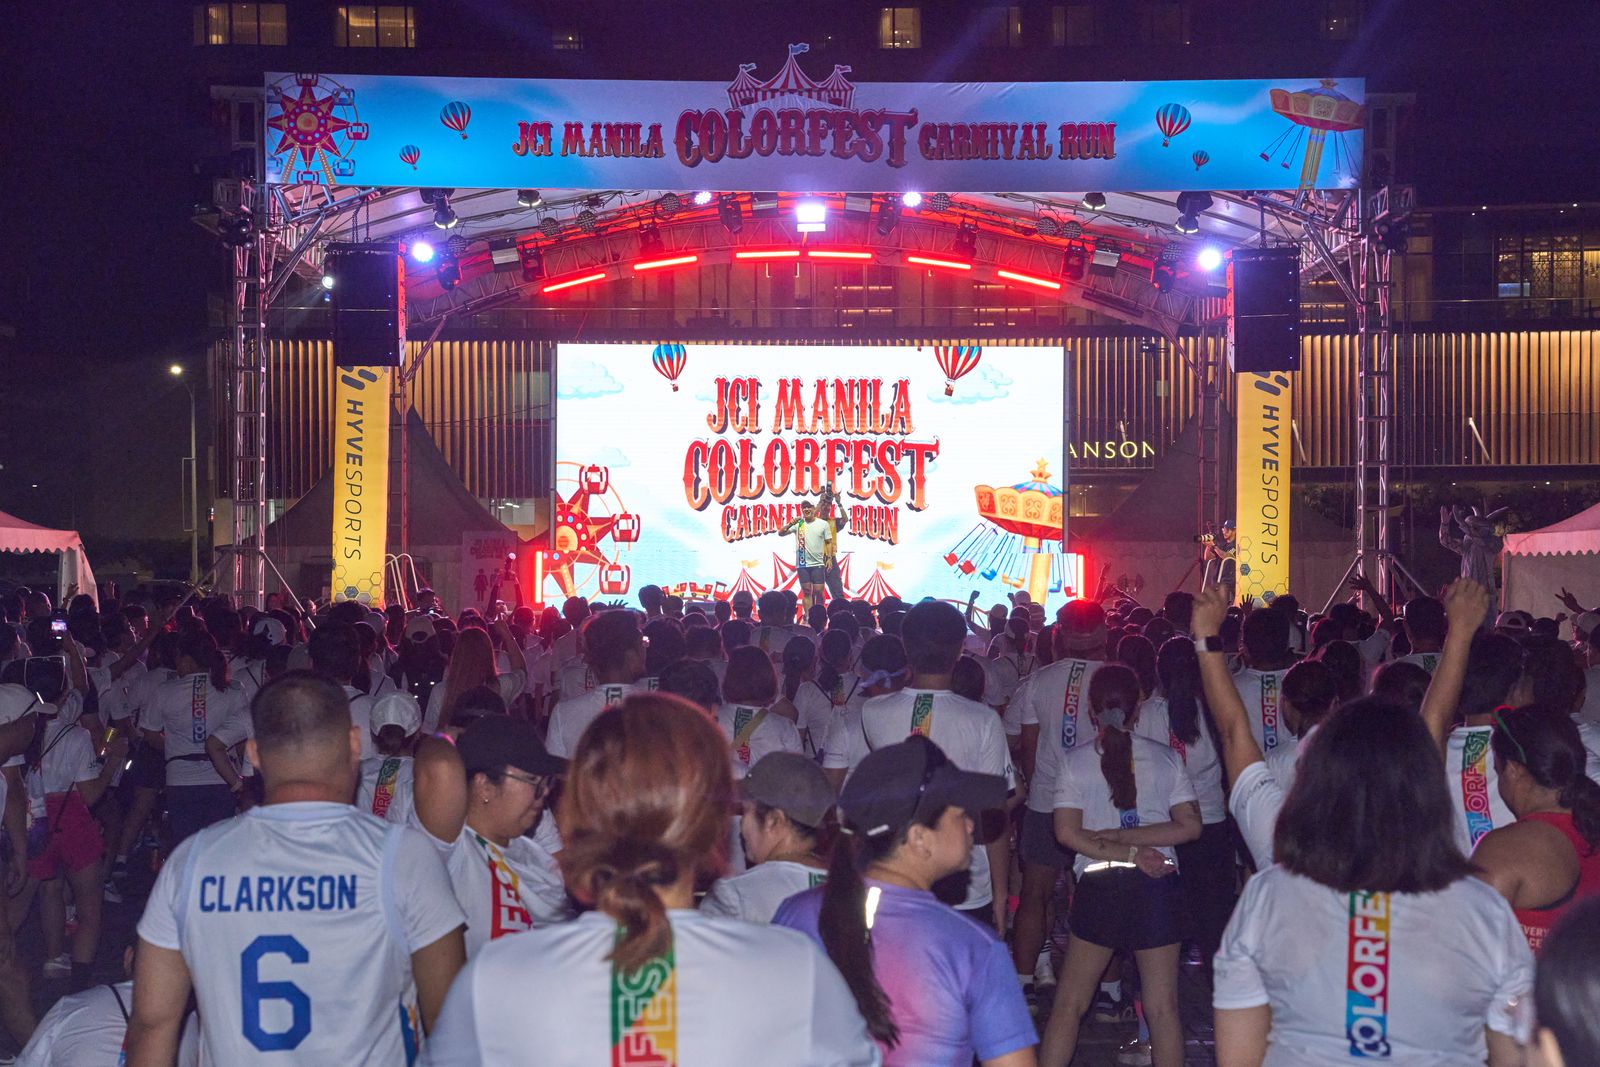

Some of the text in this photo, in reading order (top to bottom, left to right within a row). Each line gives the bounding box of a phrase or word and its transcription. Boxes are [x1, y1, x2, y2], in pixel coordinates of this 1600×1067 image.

[512, 107, 1117, 168] JCI MANILA COLORFEST CARNIVAL RUN
[706, 374, 915, 435] JCI MANILA
[344, 399, 363, 560] HYVESPORTS
[683, 435, 940, 512] COLORFEST
[1261, 404, 1280, 565] HYVESPORTS
[848, 505, 901, 546] RUN
[1063, 663, 1087, 746] COLORFEST
[200, 874, 357, 912] CLARKSON
[1520, 924, 1550, 938] VERY
[241, 935, 311, 1052] 6
[1351, 890, 1388, 1057] COLORFE
